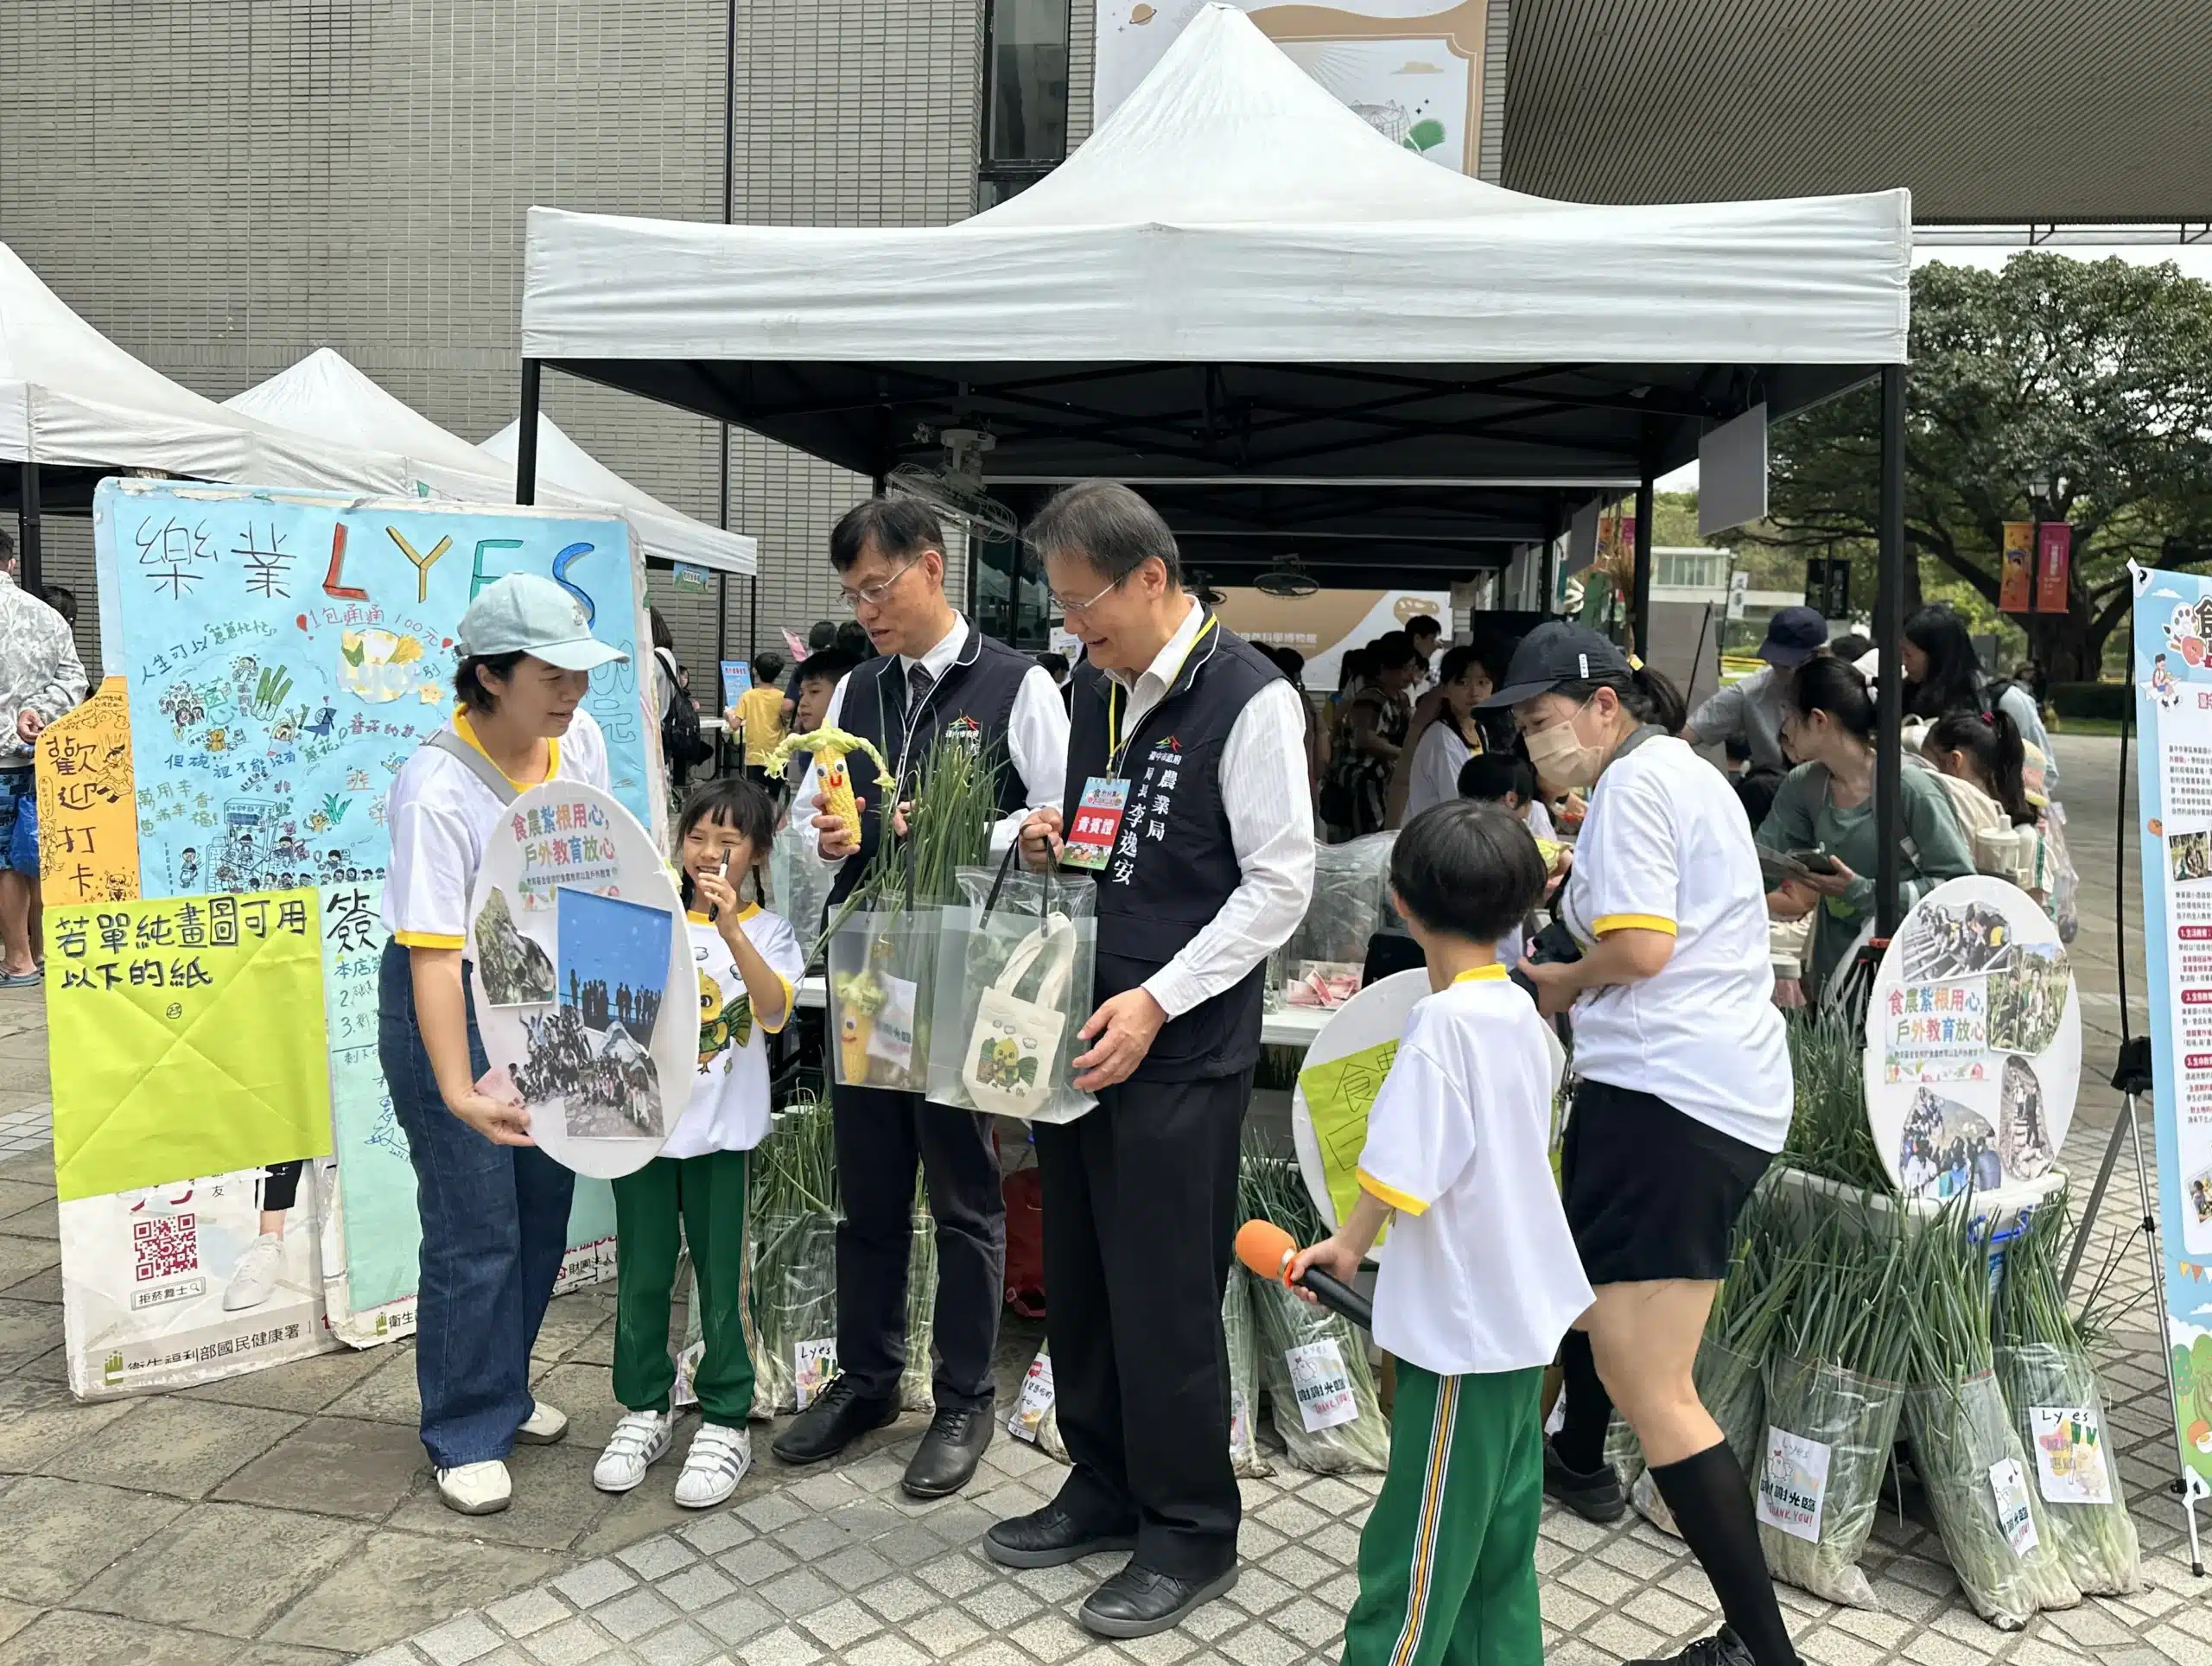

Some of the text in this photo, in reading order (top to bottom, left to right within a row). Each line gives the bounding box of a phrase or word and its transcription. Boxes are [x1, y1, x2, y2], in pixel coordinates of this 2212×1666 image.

[136, 516, 297, 601] 樂業
[46, 735, 98, 897] 歡迎打卡
[1146, 769, 1179, 842] 農業局
[524, 836, 616, 871] 戶外教育放心
[1112, 803, 1147, 886] 李逸安
[54, 895, 308, 958] 若單純畫圖可用
[60, 958, 213, 990] 以下的紙
[1896, 1017, 1985, 1045] 戶外教育放心
[569, 1250, 617, 1276] 財團法人
[388, 1310, 417, 1329] 衛生
[801, 1345, 831, 1360] Lyes
[2042, 1409, 2088, 1424] Lyes
[1782, 1436, 1809, 1459] Lyes
[2004, 1506, 2029, 1534] 謝光臨
